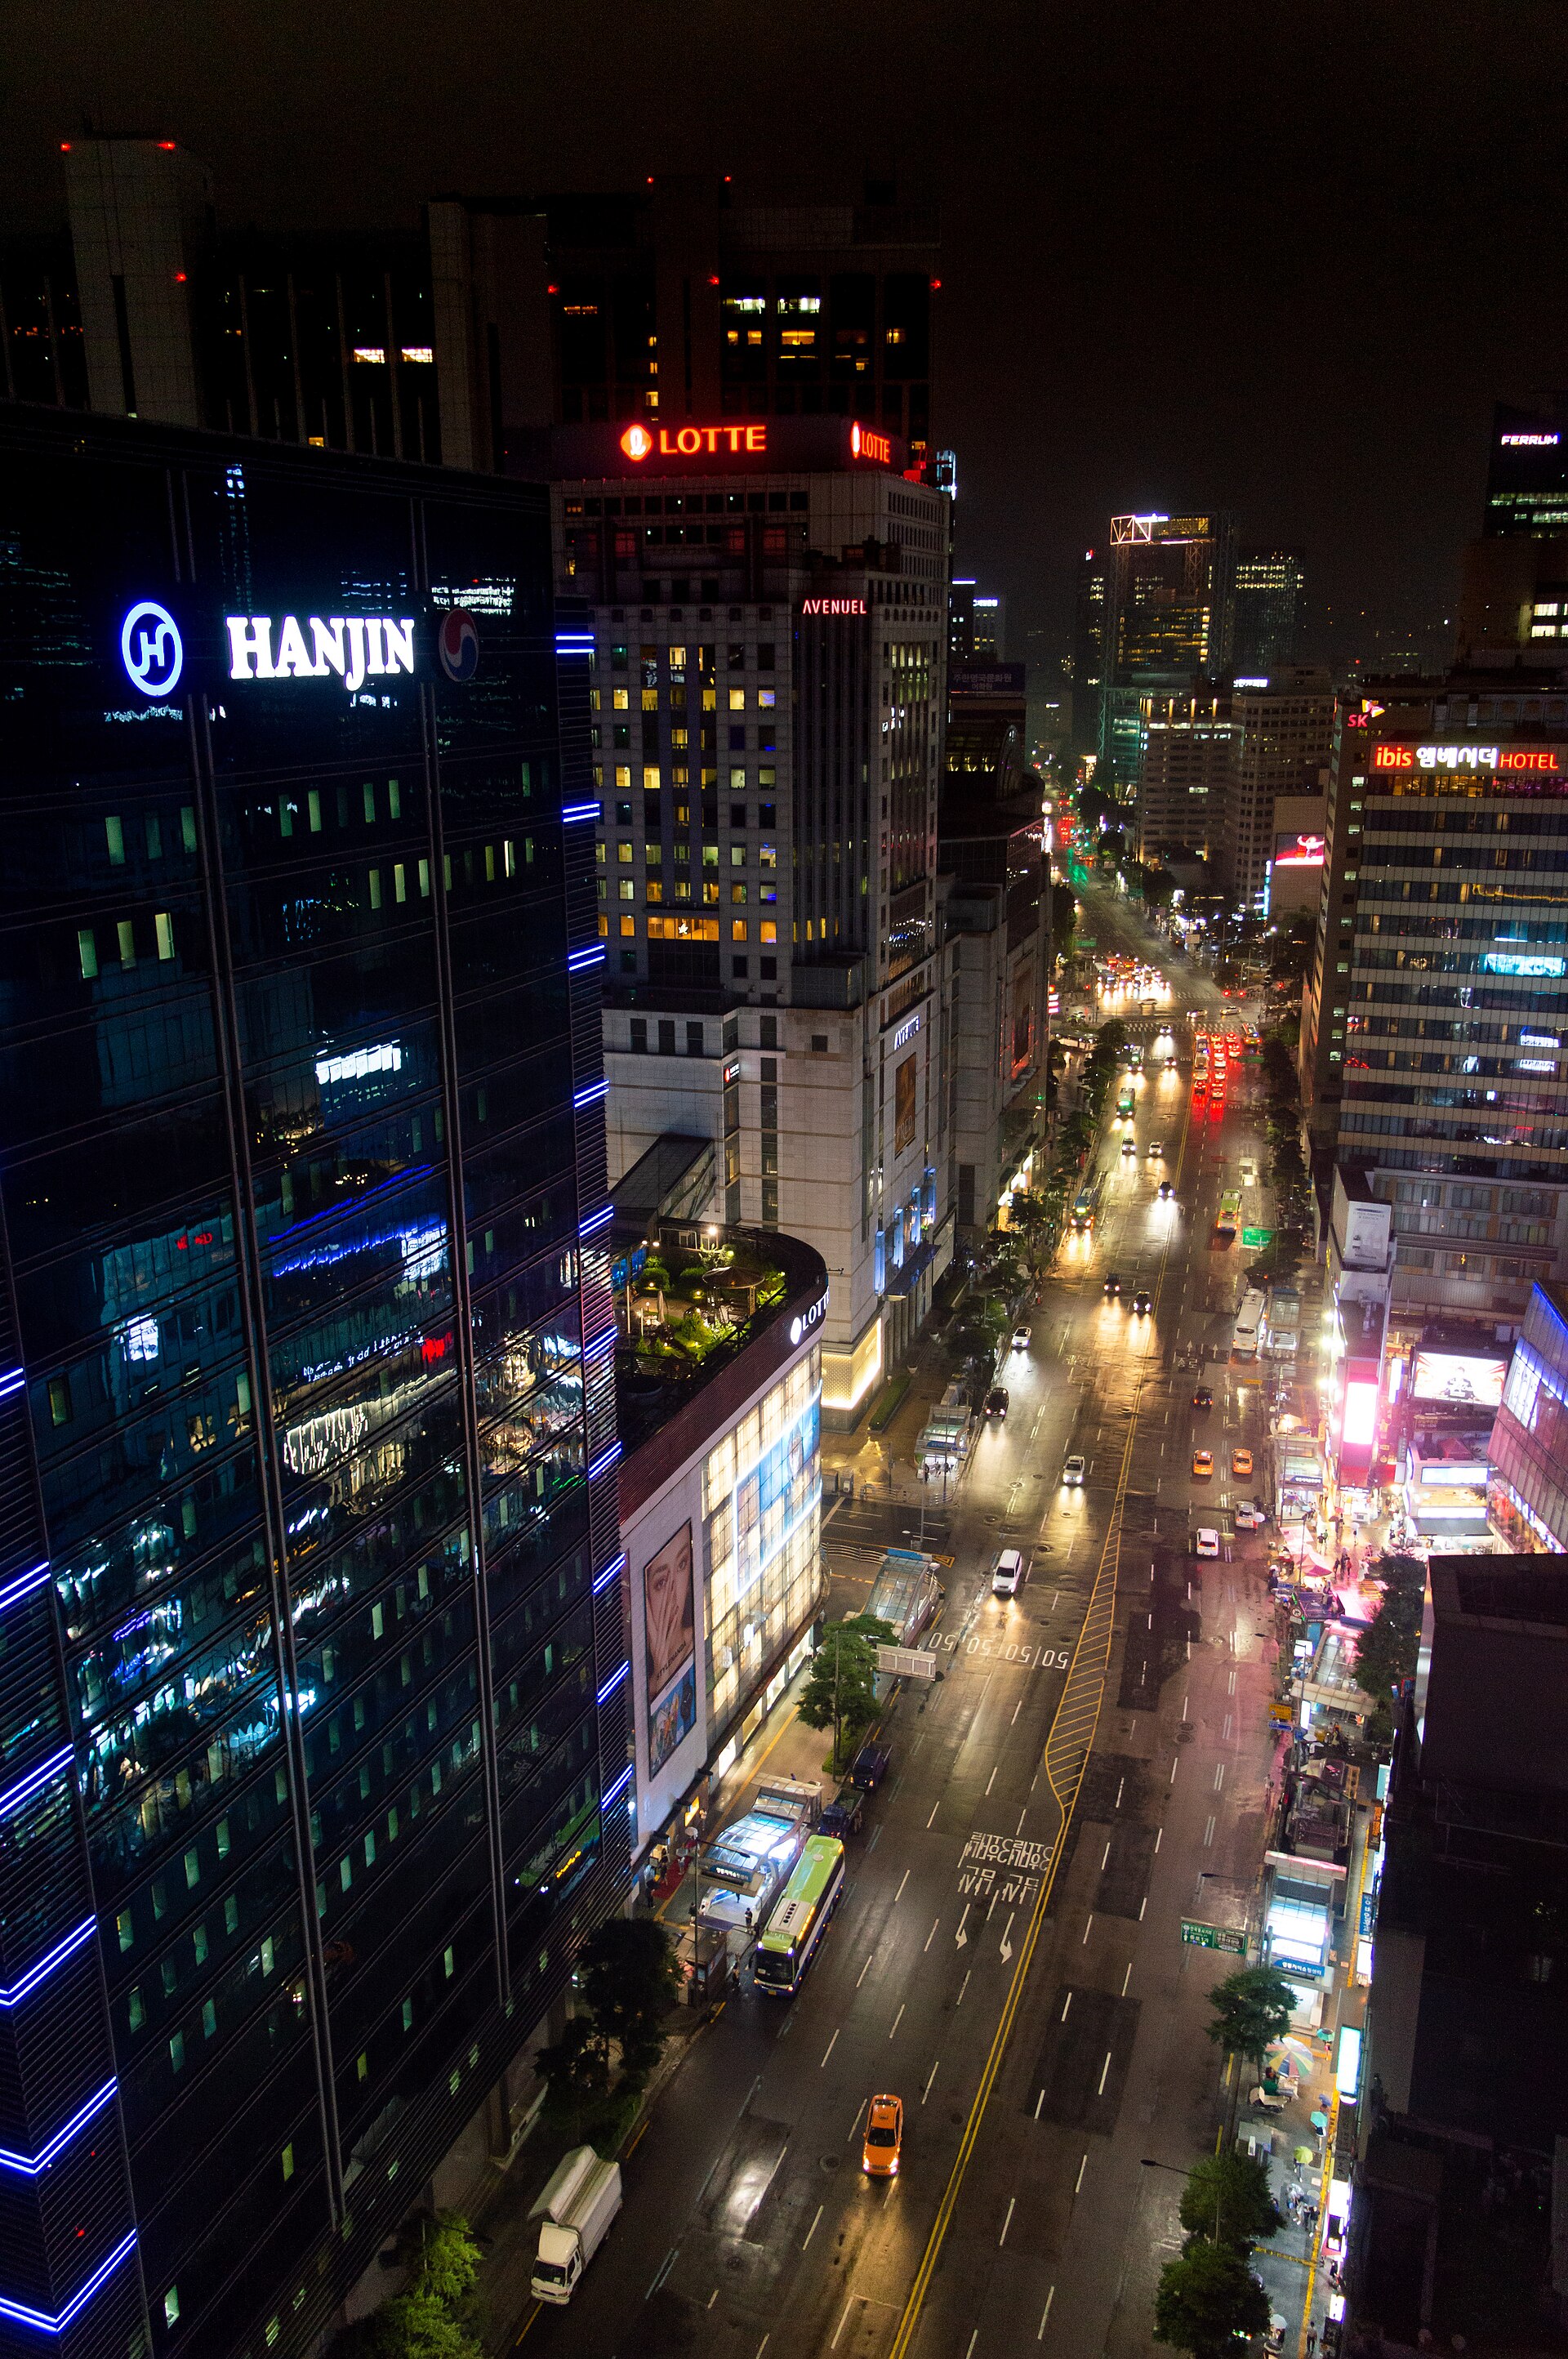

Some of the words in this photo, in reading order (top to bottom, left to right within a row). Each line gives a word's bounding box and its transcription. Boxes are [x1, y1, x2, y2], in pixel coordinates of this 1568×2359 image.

[659, 426, 766, 453] LOTTE
[861, 430, 890, 463] LOTTE
[1501, 435, 1558, 445] FERRUM
[802, 600, 867, 614] AVENUEL
[225, 615, 415, 692] HANJIN
[1348, 714, 1369, 727] SK
[1375, 747, 1413, 768] ibis
[1499, 752, 1559, 770] HOTEL
